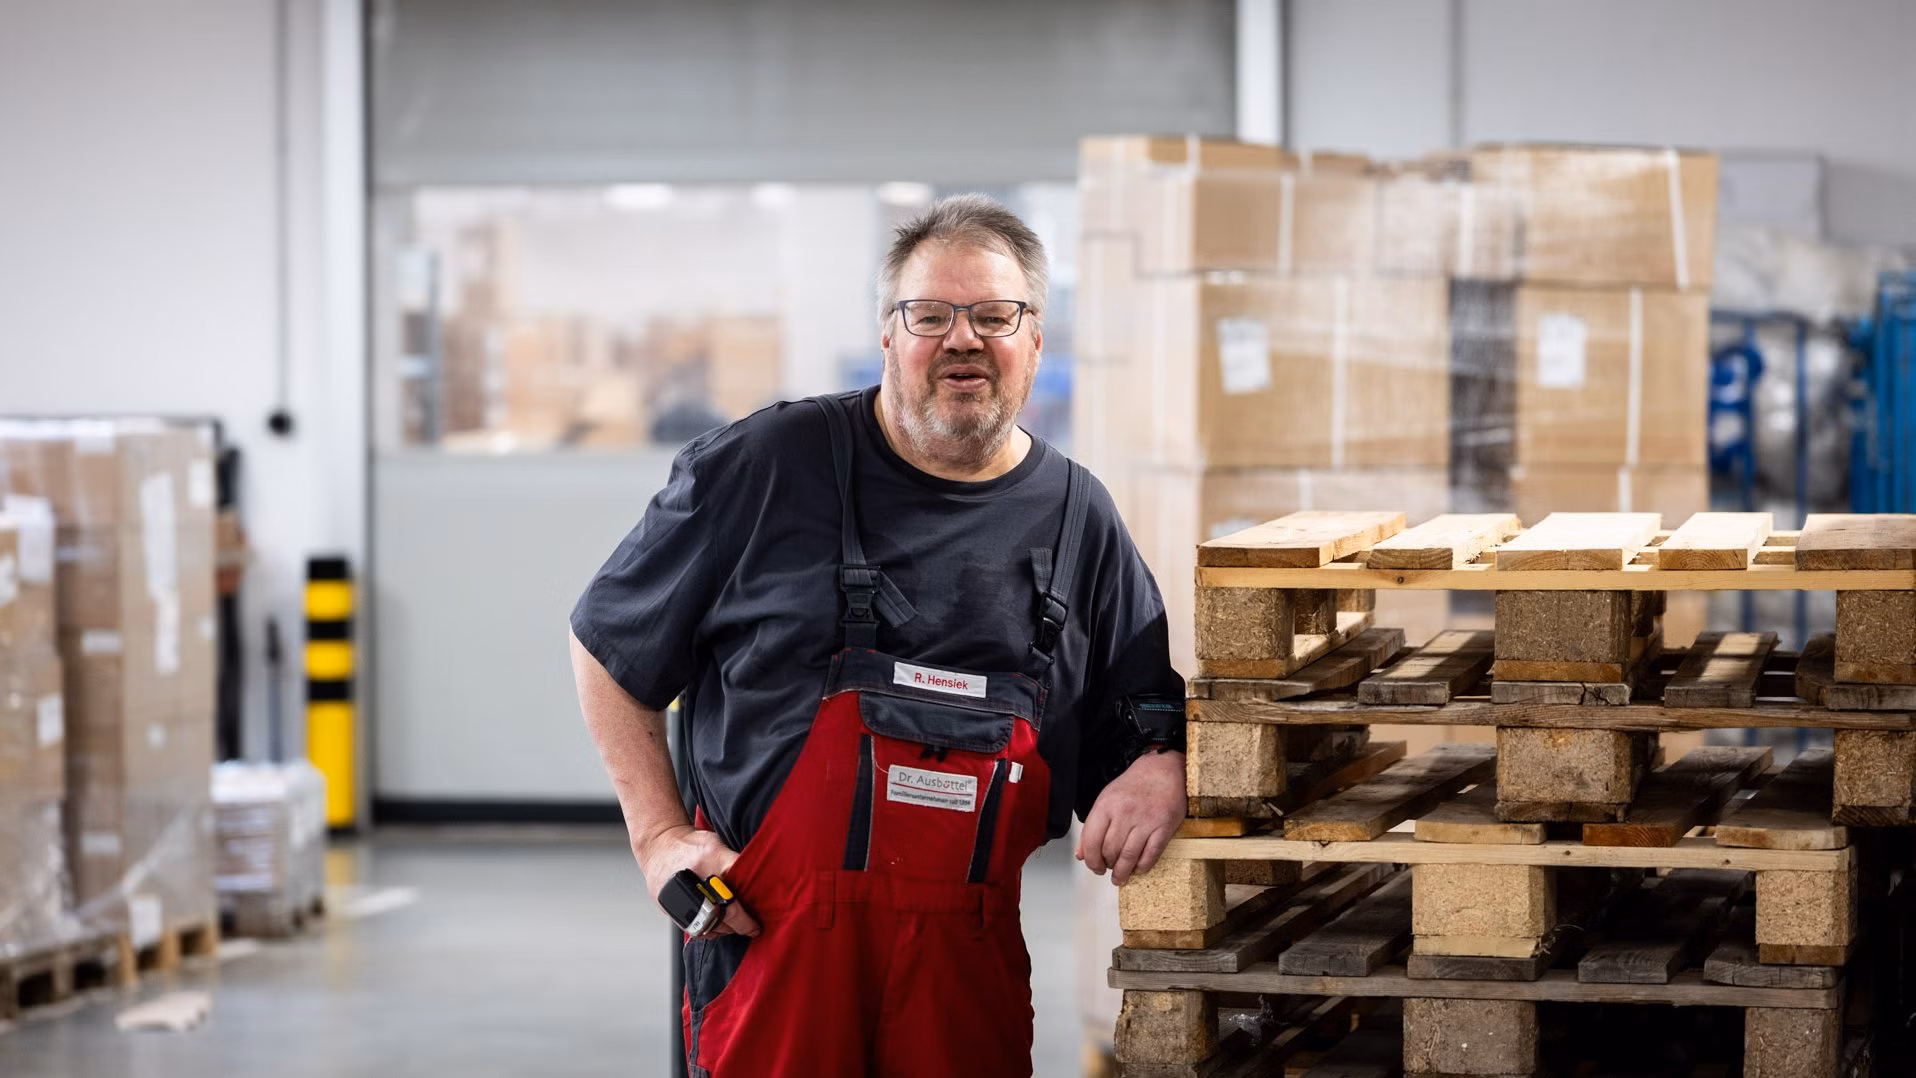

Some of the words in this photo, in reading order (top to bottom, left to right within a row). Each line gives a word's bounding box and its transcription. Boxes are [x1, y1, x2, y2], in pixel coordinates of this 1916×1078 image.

[914, 672, 925, 684] R.
[927, 674, 969, 690] Hensiek
[898, 771, 913, 784] Dr.
